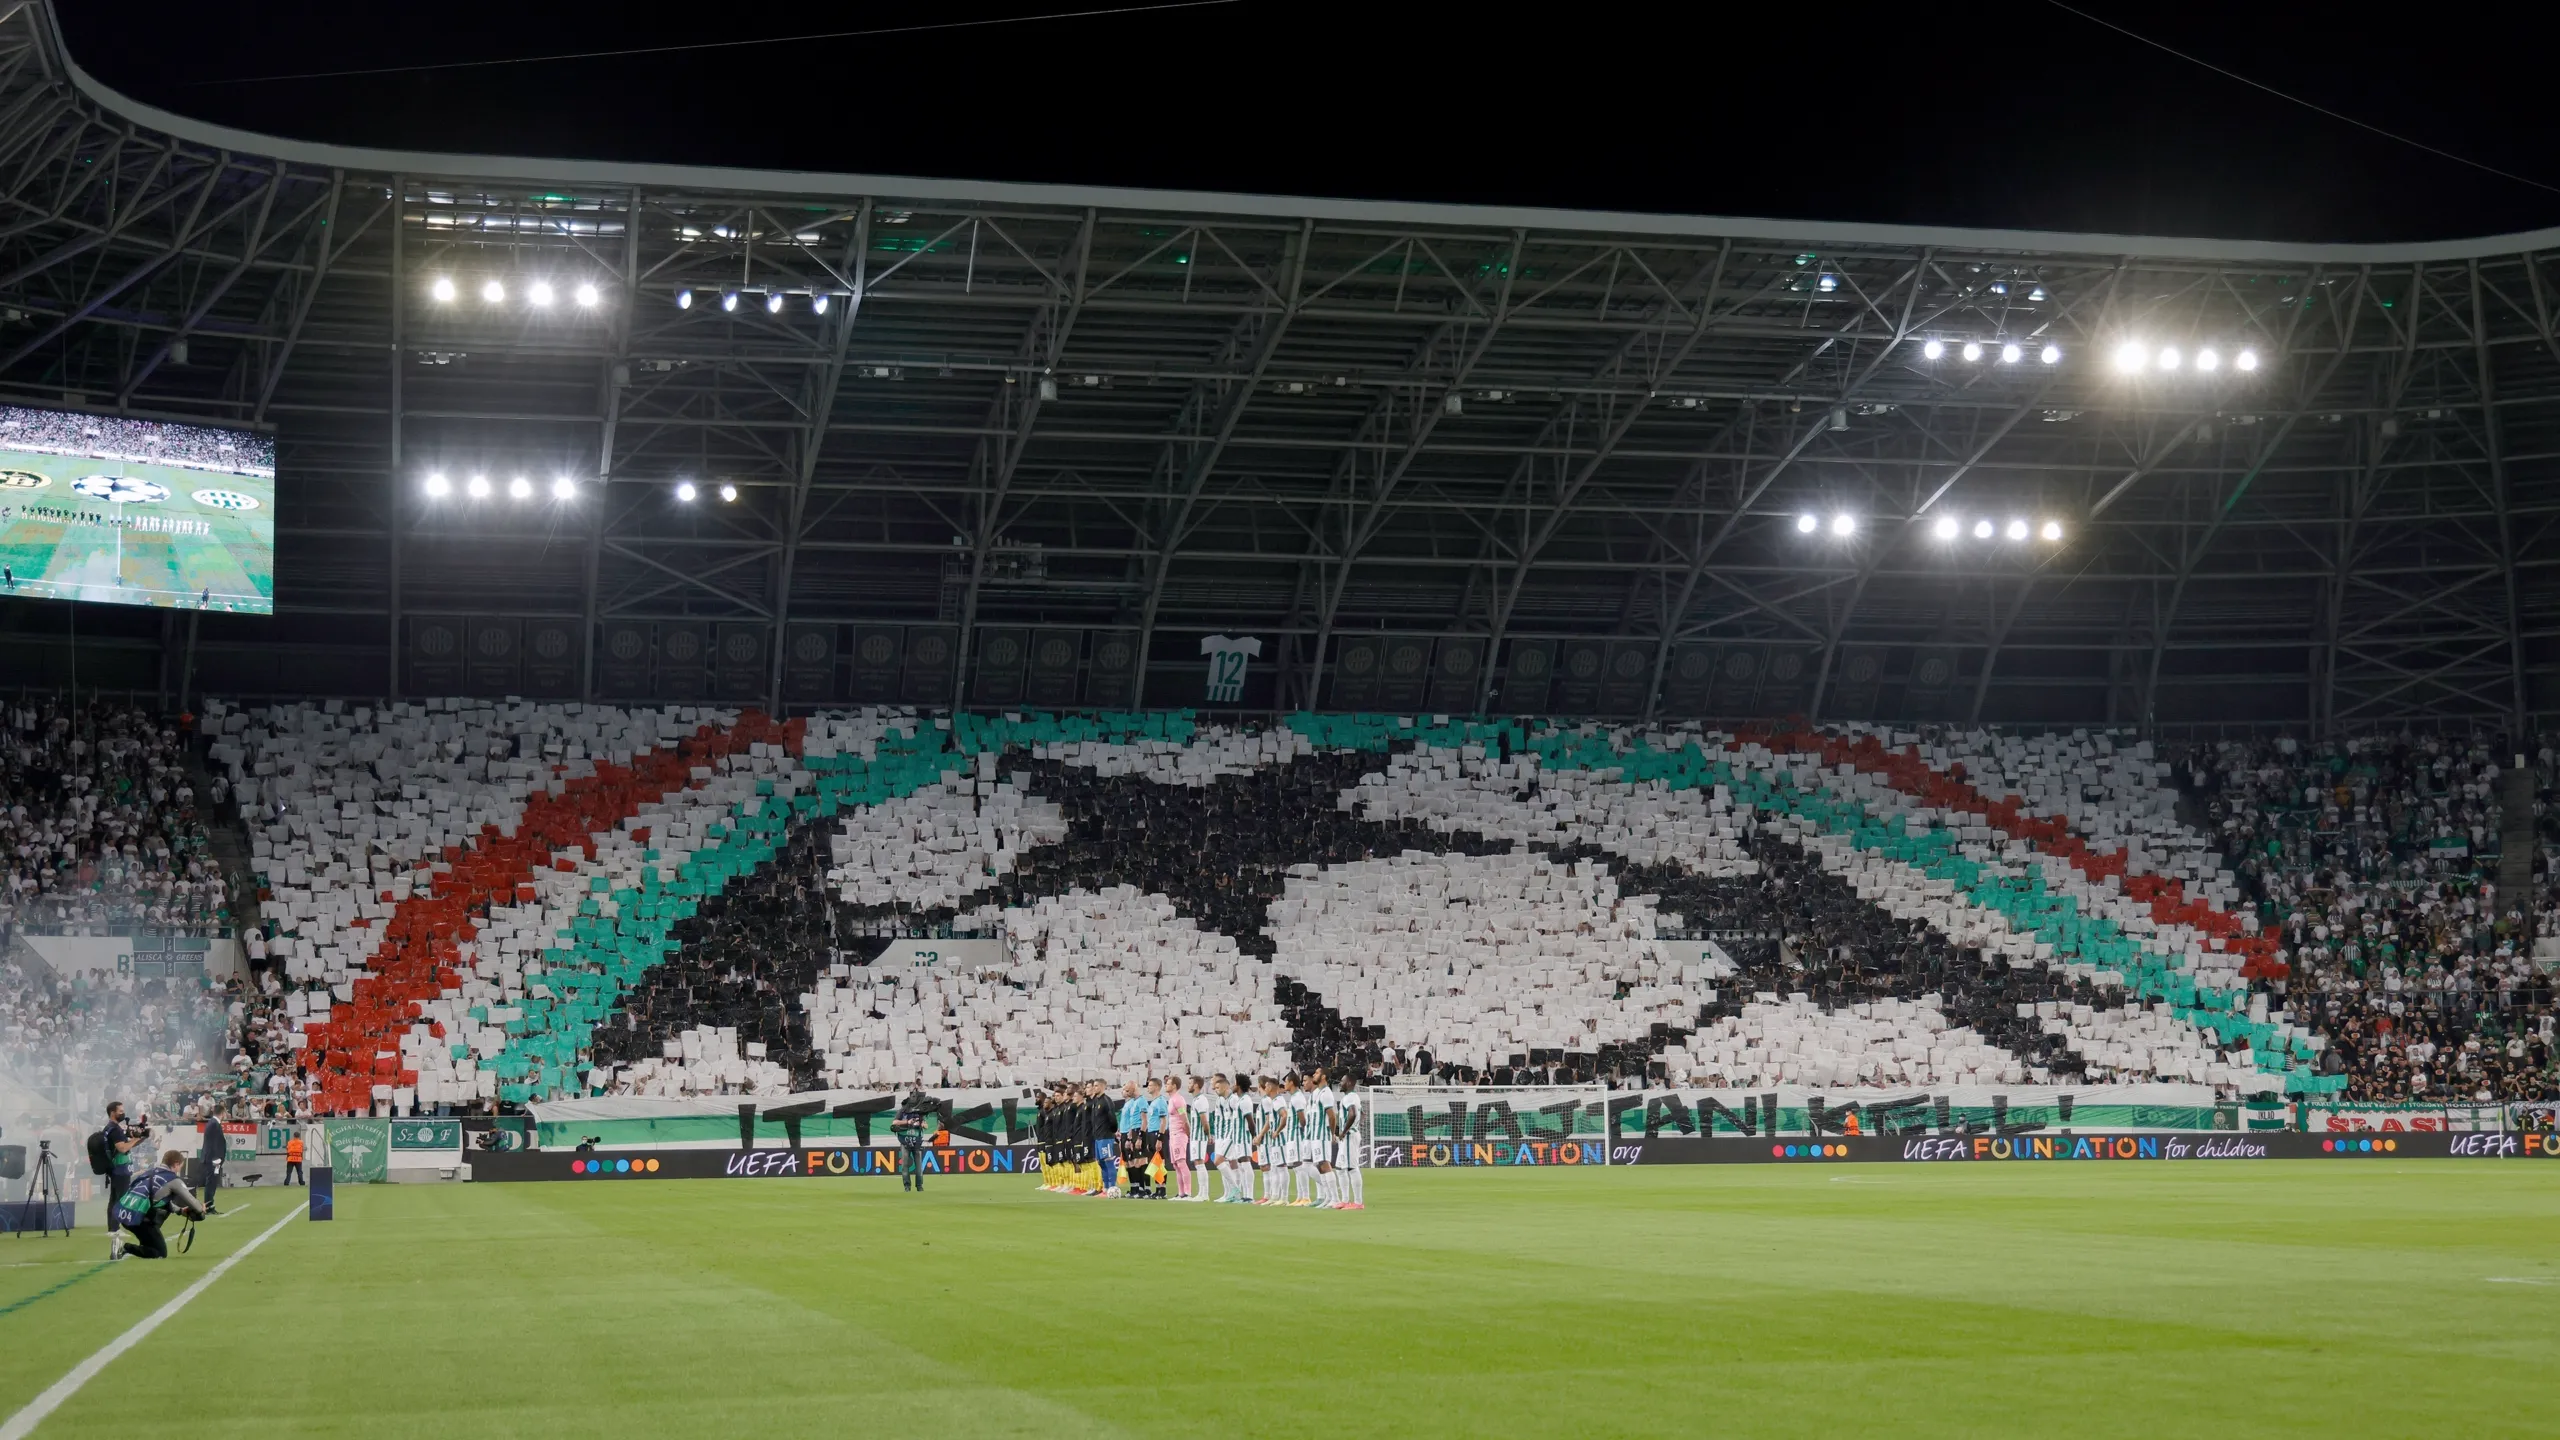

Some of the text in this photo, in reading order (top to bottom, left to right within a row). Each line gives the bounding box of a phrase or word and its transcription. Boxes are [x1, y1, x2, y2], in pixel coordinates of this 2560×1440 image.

[1216, 650, 1244, 685] 12
[117, 954, 130, 973] B
[1407, 1093, 1778, 1141] HAJTANI
[1808, 1094, 2074, 1136] KELL!
[235, 1137, 246, 1145] 99
[268, 1128, 291, 1150] B1
[397, 1128, 414, 1142] Sz
[440, 1128, 453, 1141] F
[2450, 1133, 2560, 1156] UEFA FO
[1357, 1143, 1643, 1168] EFA FOUNDATION org
[1903, 1137, 2266, 1160] UEFA FOUNDATION for children
[725, 1151, 800, 1176] UEFA
[1021, 1148, 1041, 1174] fo
[124, 1195, 138, 1208] TV
[117, 1209, 133, 1223] 104
